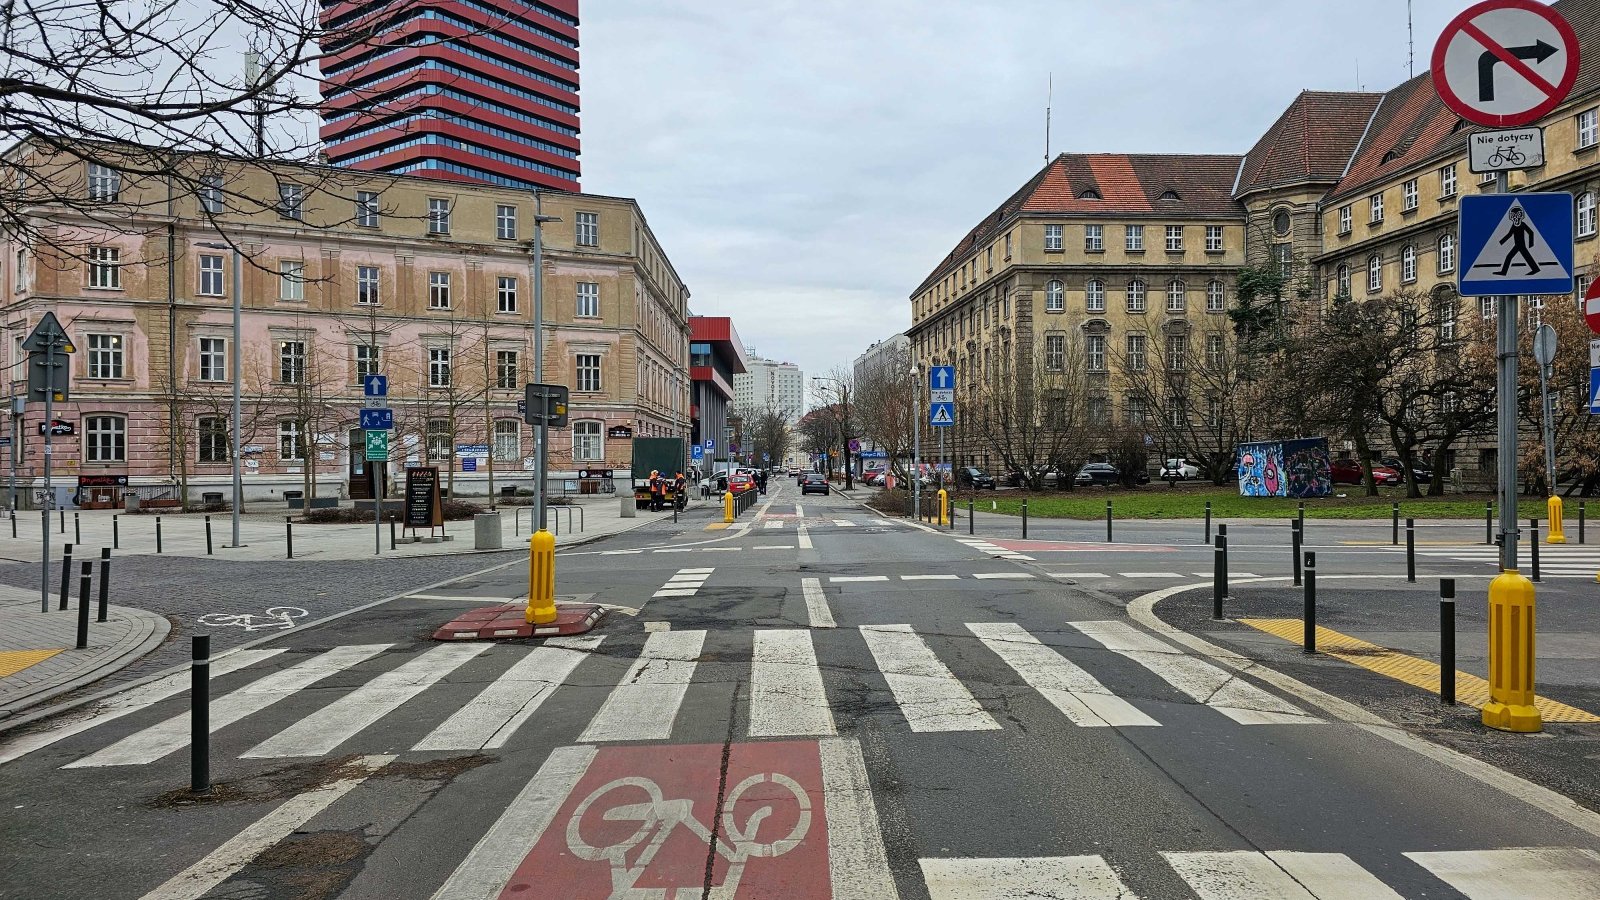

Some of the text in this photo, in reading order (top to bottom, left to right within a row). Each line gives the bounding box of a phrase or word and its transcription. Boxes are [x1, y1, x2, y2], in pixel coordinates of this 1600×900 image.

[1477, 133, 1534, 144] Nie dotyczy
[706, 440, 713, 448] P
[694, 446, 701, 455] P
